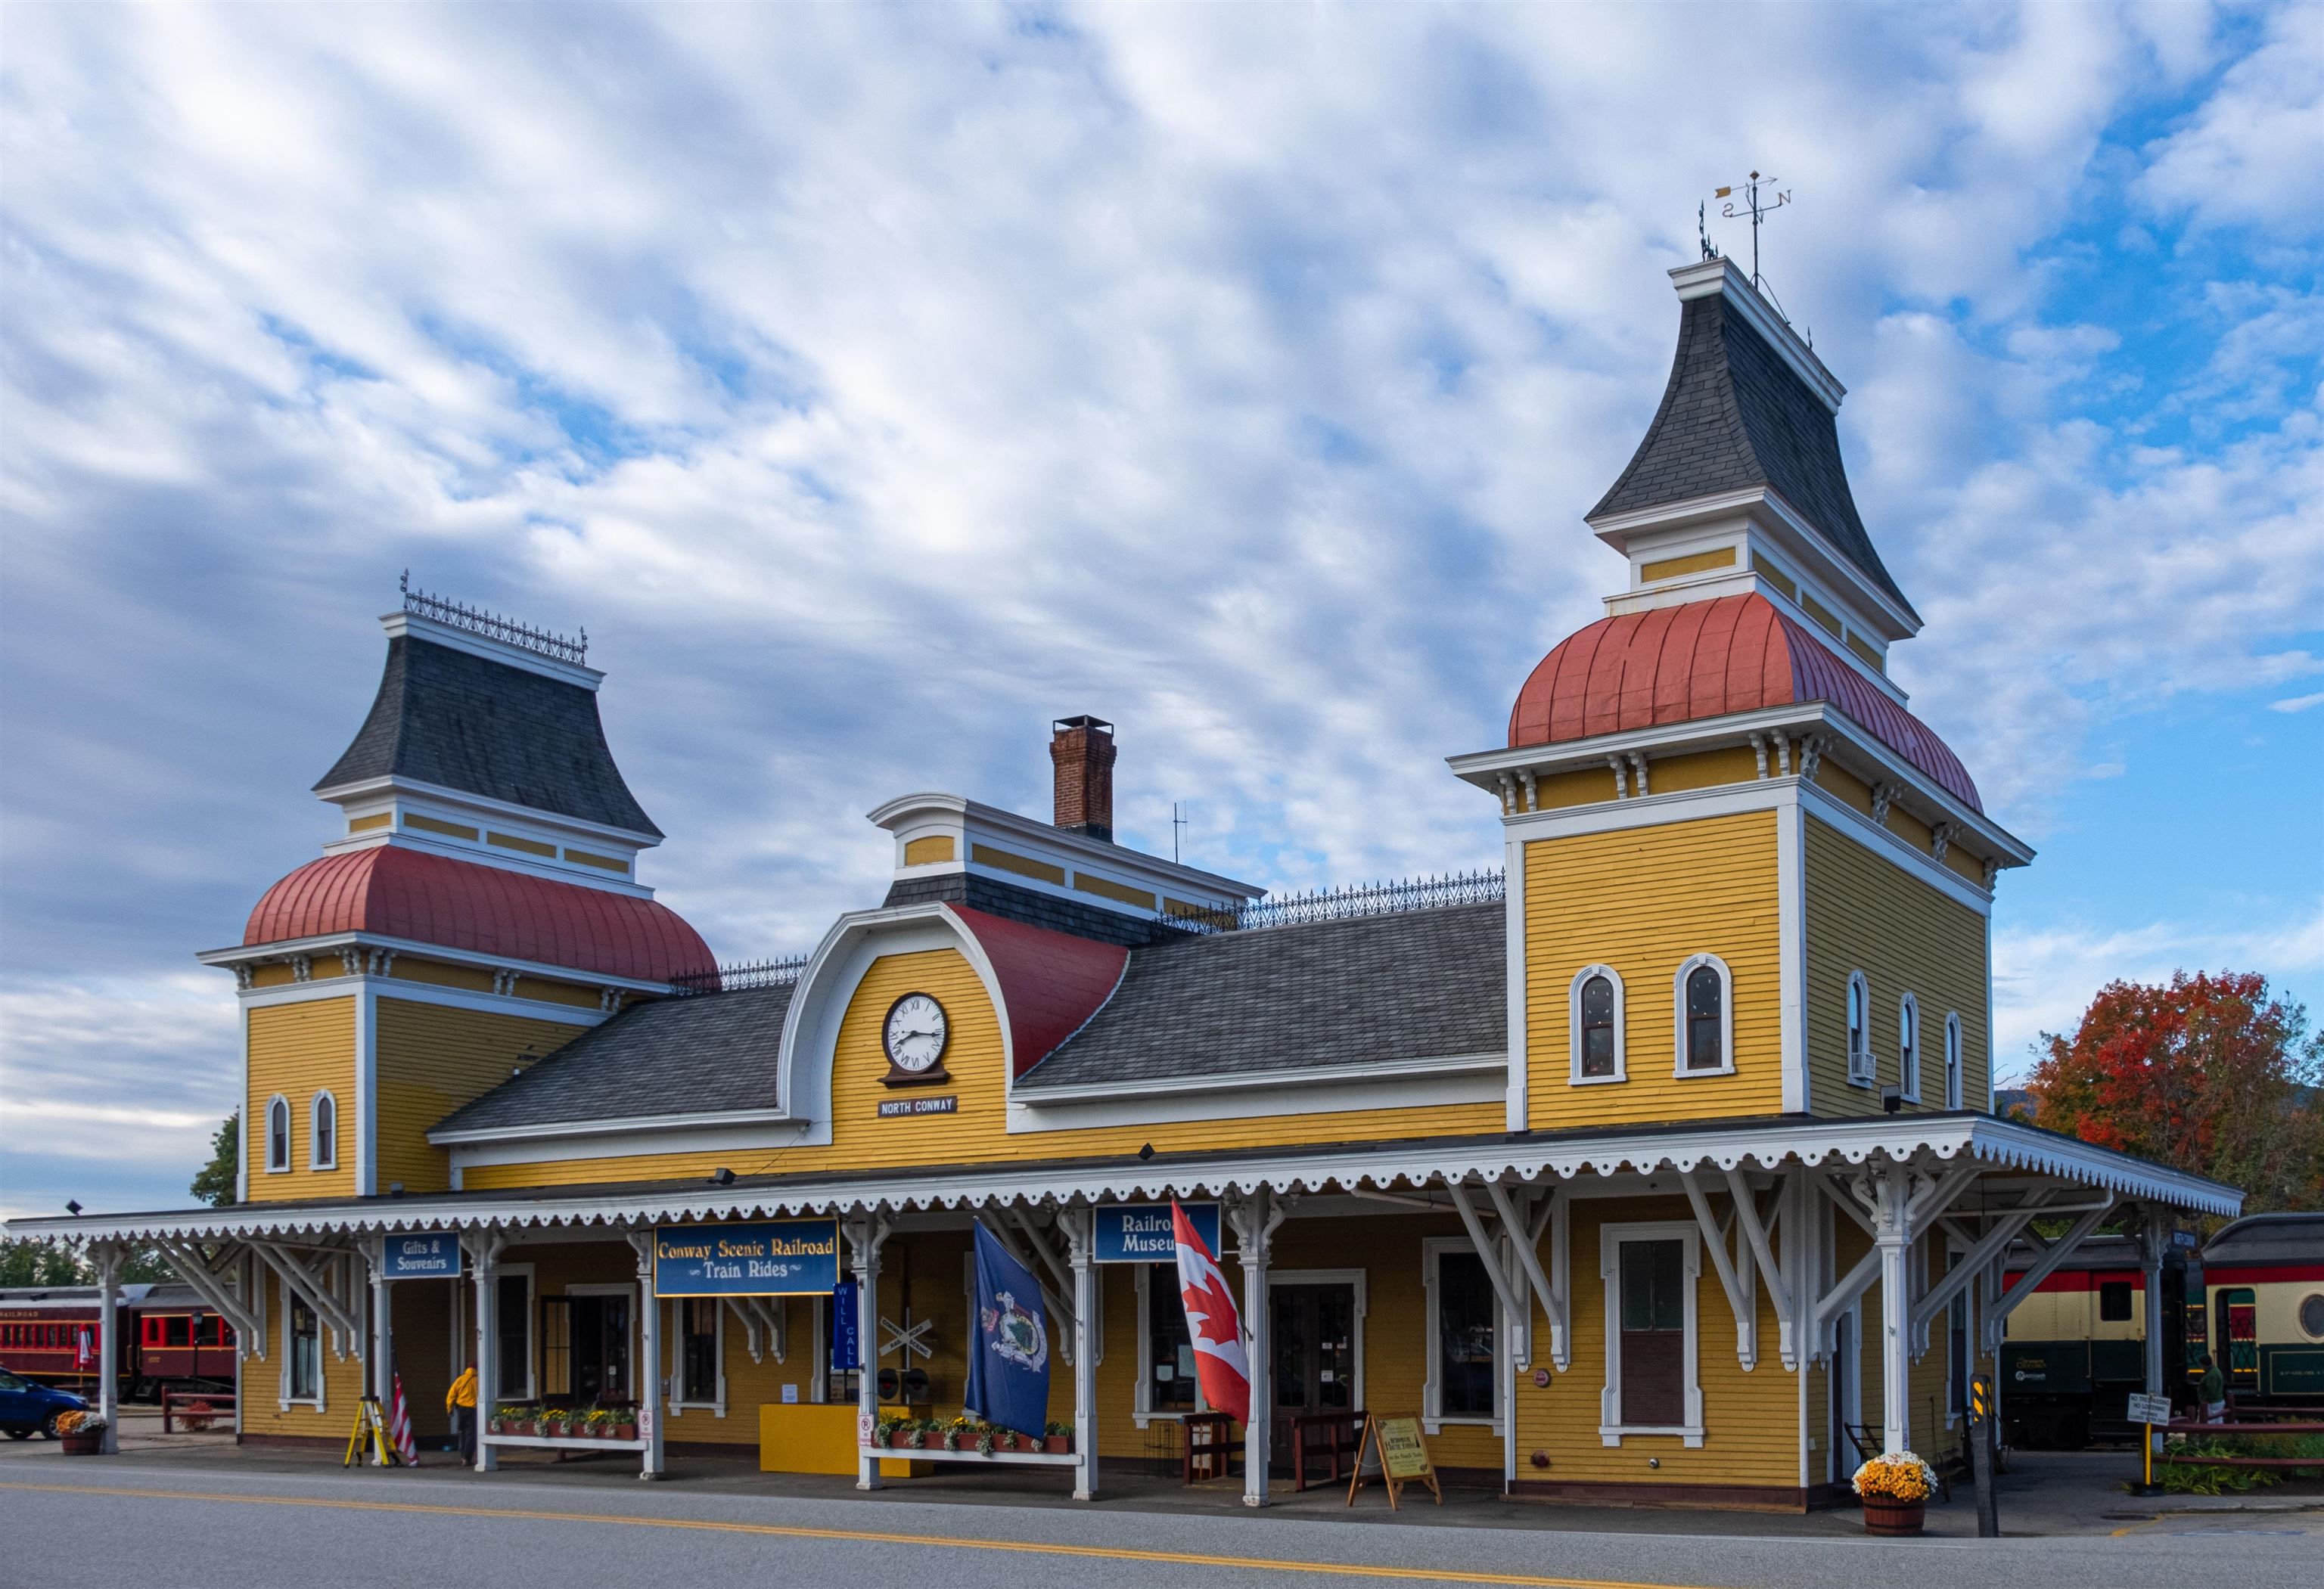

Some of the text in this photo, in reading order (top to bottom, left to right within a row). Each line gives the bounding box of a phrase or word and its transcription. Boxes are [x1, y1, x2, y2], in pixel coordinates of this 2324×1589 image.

[881, 1099, 952, 1114] NORTH CONWAY
[1122, 1214, 1191, 1232] Railro
[402, 1240, 440, 1254] Gifts &
[658, 1237, 834, 1260] Conway Scenic Railroad
[1122, 1234, 1175, 1252] Museu
[397, 1256, 447, 1271] Souvenirs
[703, 1260, 788, 1278] Train Rides
[837, 1287, 847, 1325] WILL
[847, 1327, 855, 1365] CALL
